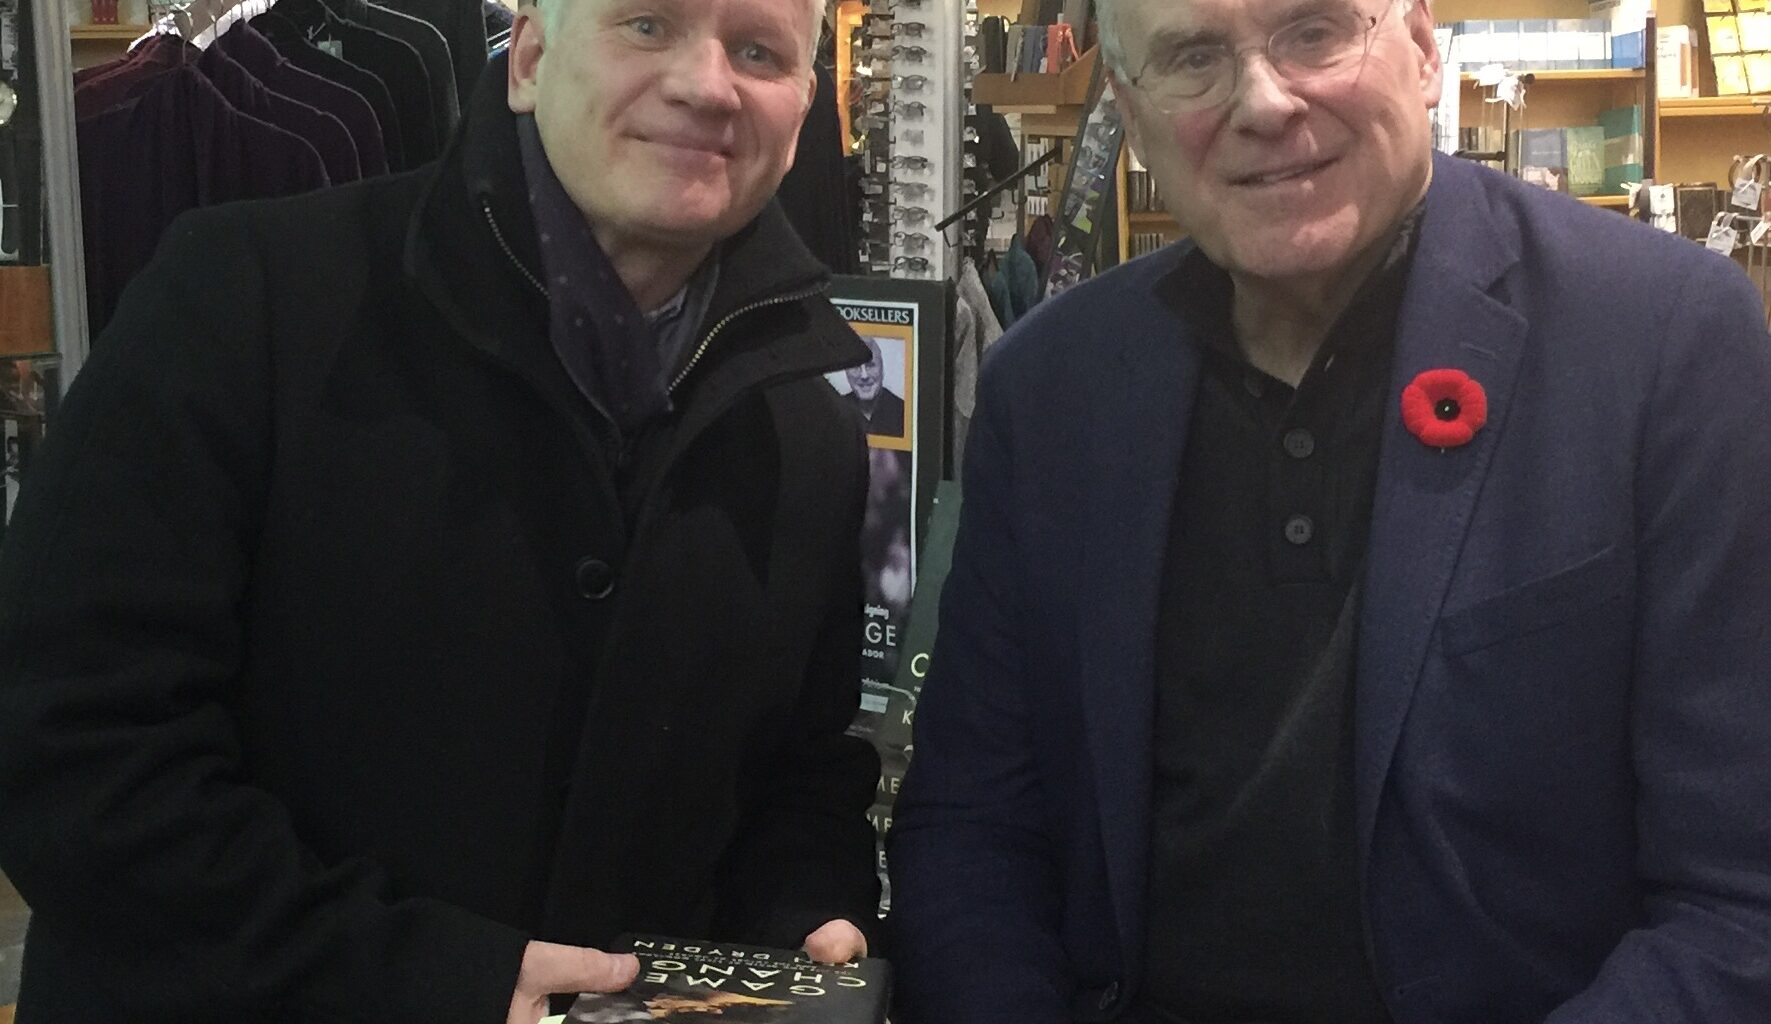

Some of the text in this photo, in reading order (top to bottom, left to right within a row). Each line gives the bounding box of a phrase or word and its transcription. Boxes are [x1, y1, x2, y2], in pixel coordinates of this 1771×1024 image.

[865, 622, 896, 646] GE
[634, 940, 771, 960] DRYDEN
[793, 956, 859, 969] KN
[644, 973, 826, 996] GAME
